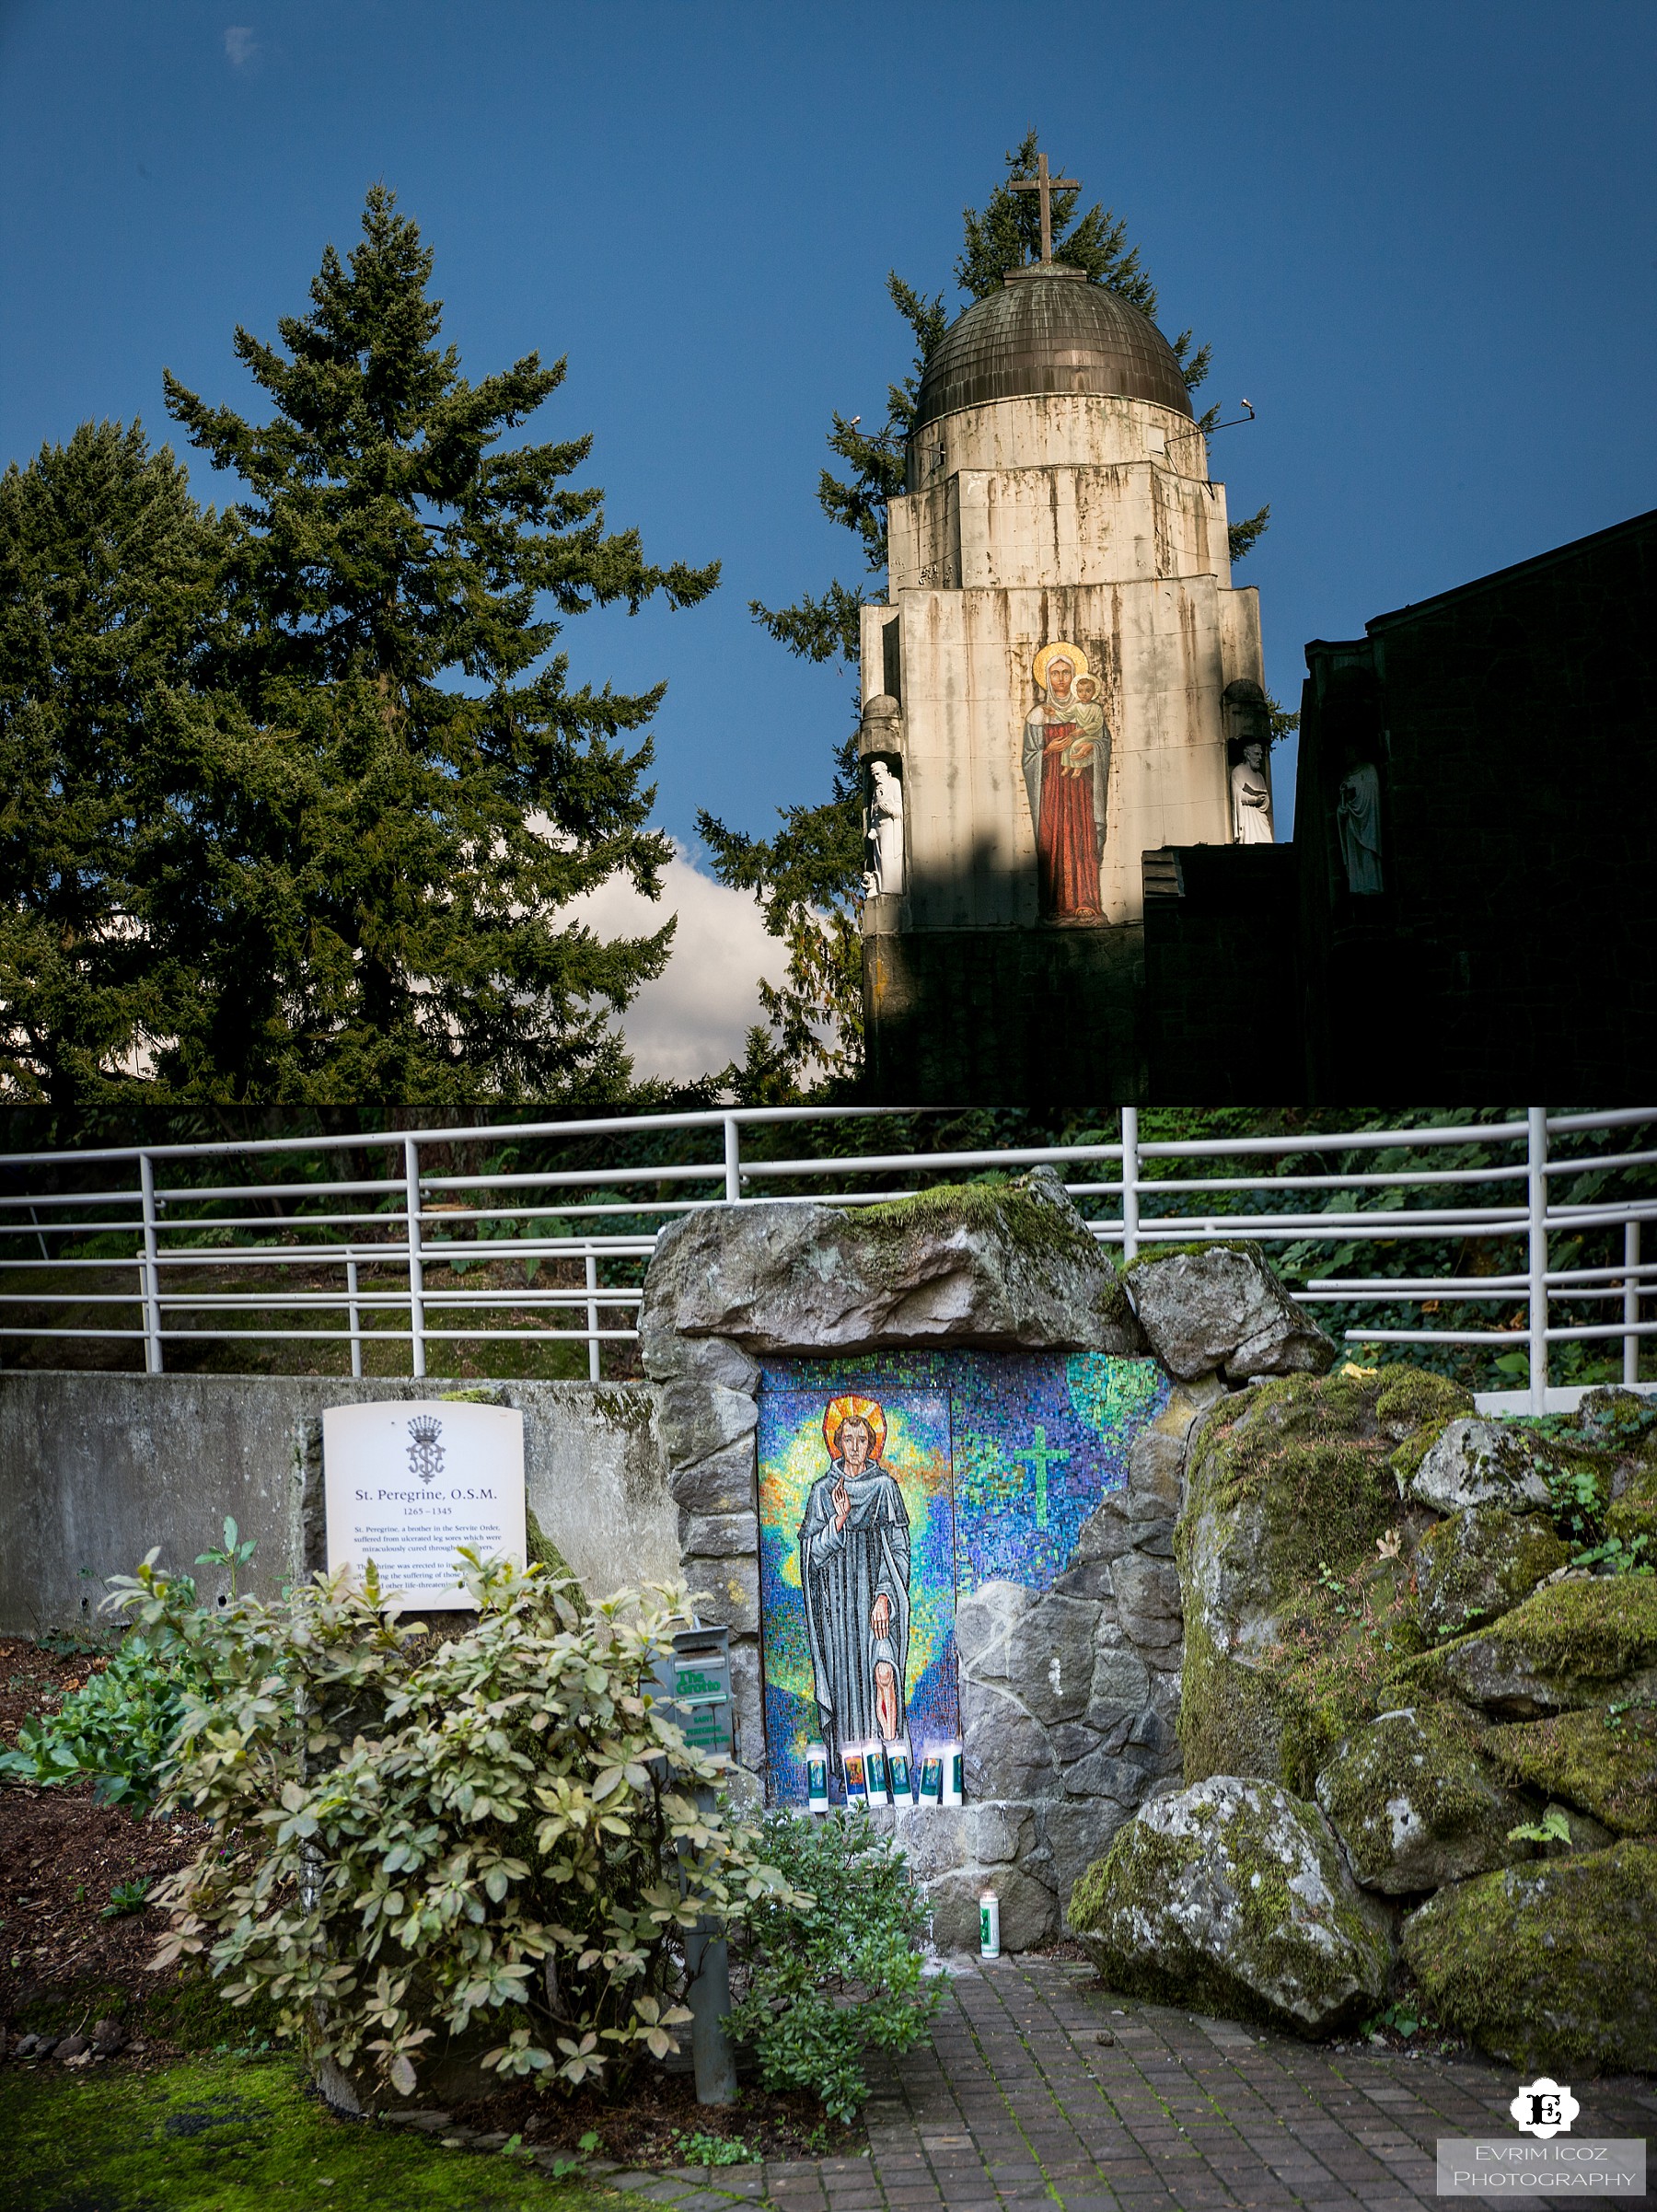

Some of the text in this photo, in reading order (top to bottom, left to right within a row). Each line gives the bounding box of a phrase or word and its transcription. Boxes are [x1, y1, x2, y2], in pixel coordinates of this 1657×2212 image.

[355, 1488, 497, 1503] St. Peregrine, O.S.M.
[433, 1535, 444, 1543] leg
[362, 1545, 406, 1553] miraculously
[428, 1544, 456, 1552] through
[375, 1562, 395, 1570] hrine
[403, 1571, 435, 1581] suffering
[677, 1670, 705, 1686] The
[676, 1680, 722, 1695] Grotto
[693, 1715, 713, 1723] SAINT
[686, 1725, 722, 1736] PEREGRINE
